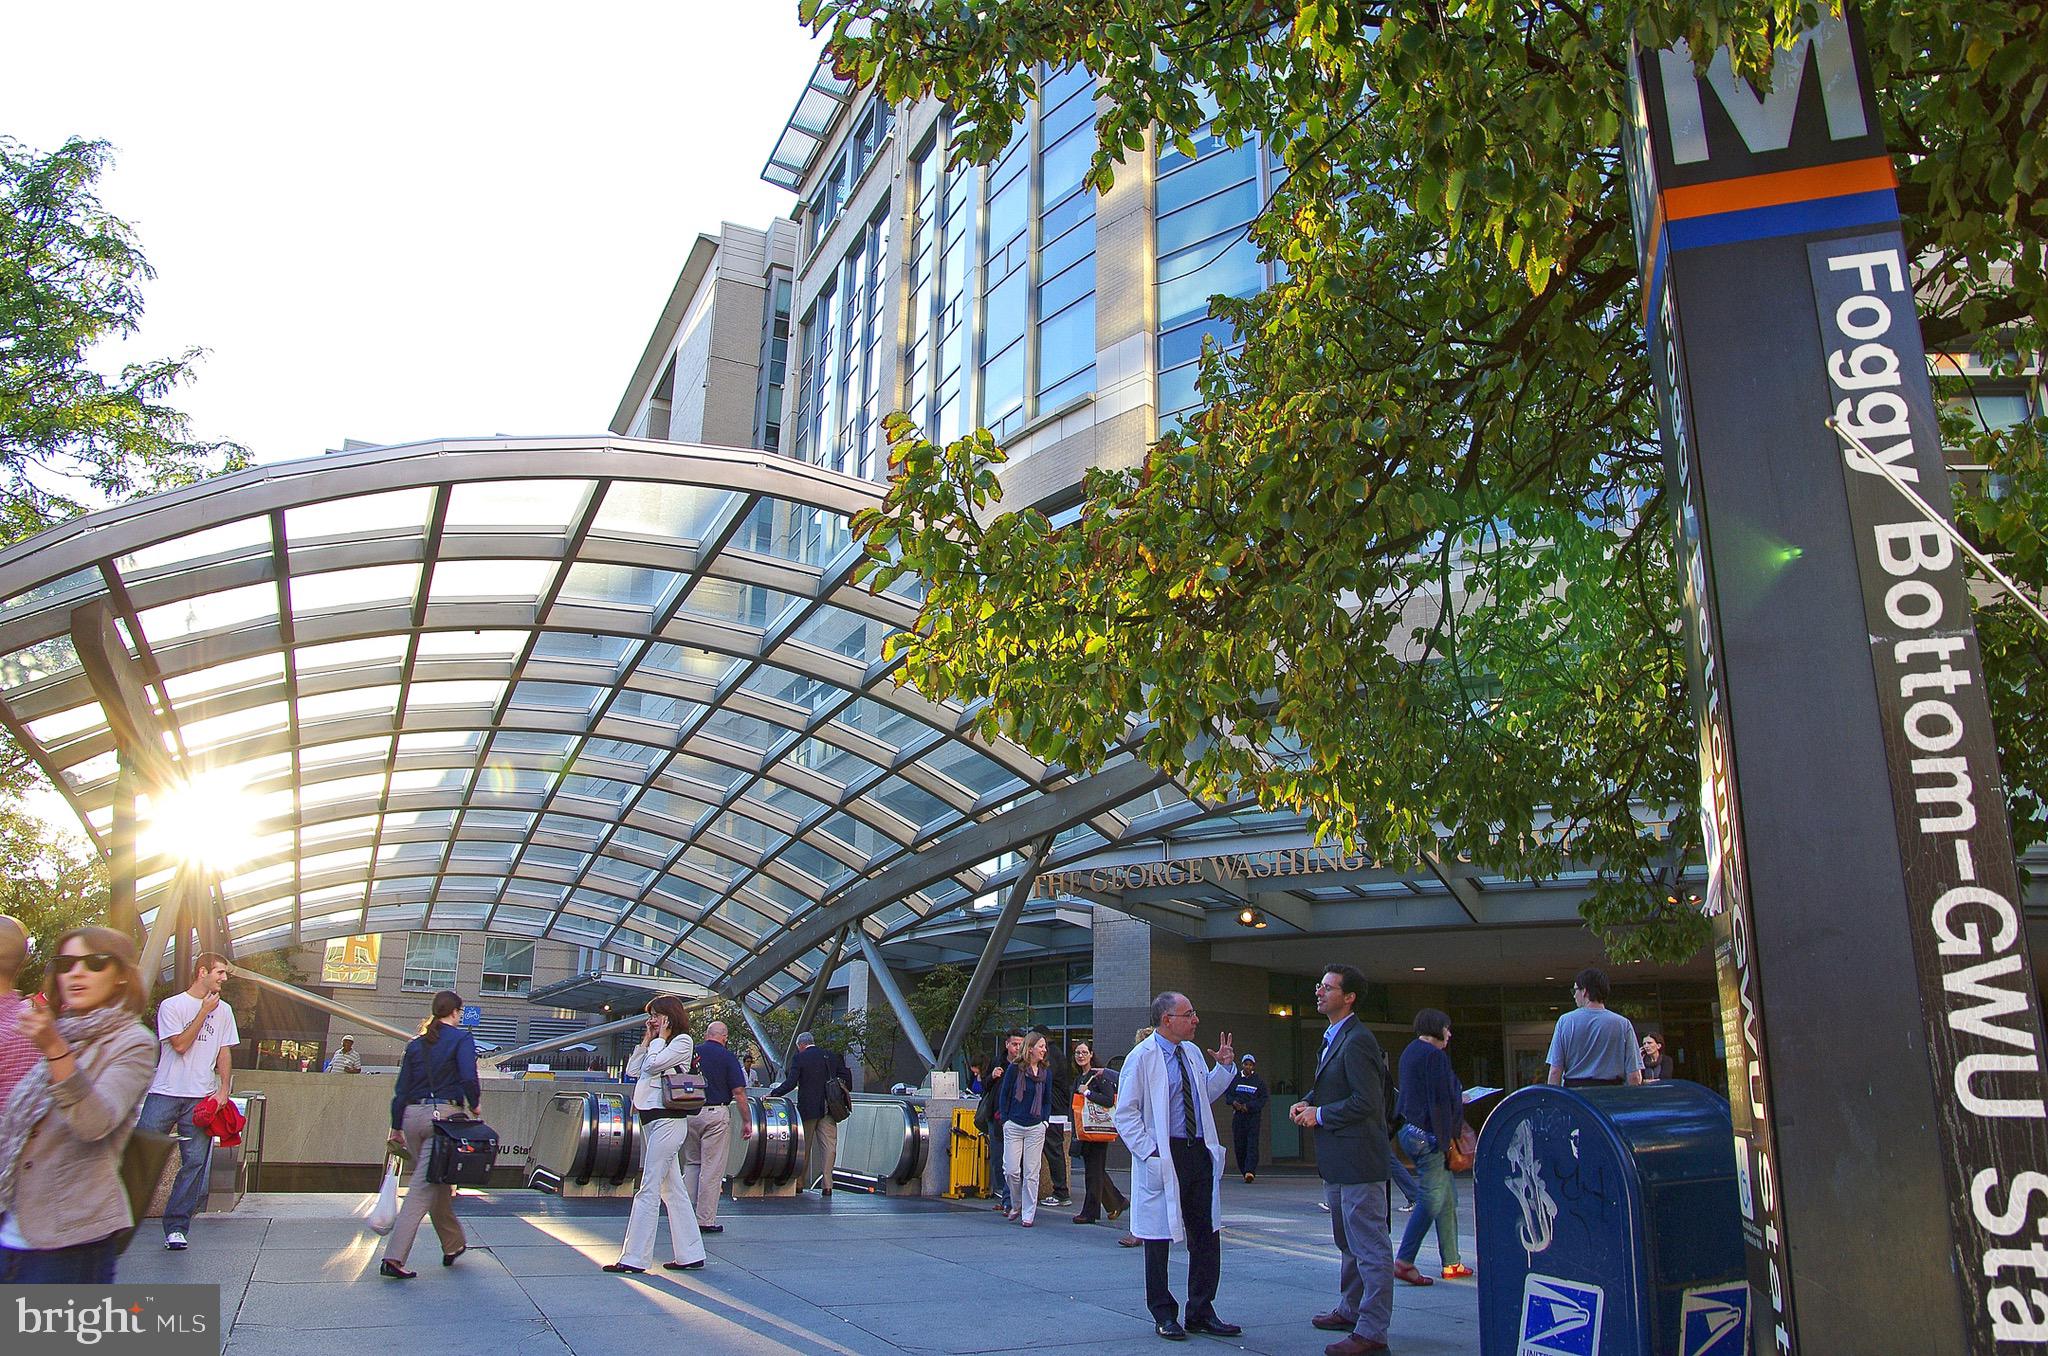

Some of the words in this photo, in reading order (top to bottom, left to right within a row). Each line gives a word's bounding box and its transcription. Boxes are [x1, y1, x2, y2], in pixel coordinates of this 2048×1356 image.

[1659, 0, 1868, 165] M
[1827, 248, 1920, 484] Foggy
[1034, 870, 1083, 899] THE
[1089, 858, 1205, 893] GEORGE
